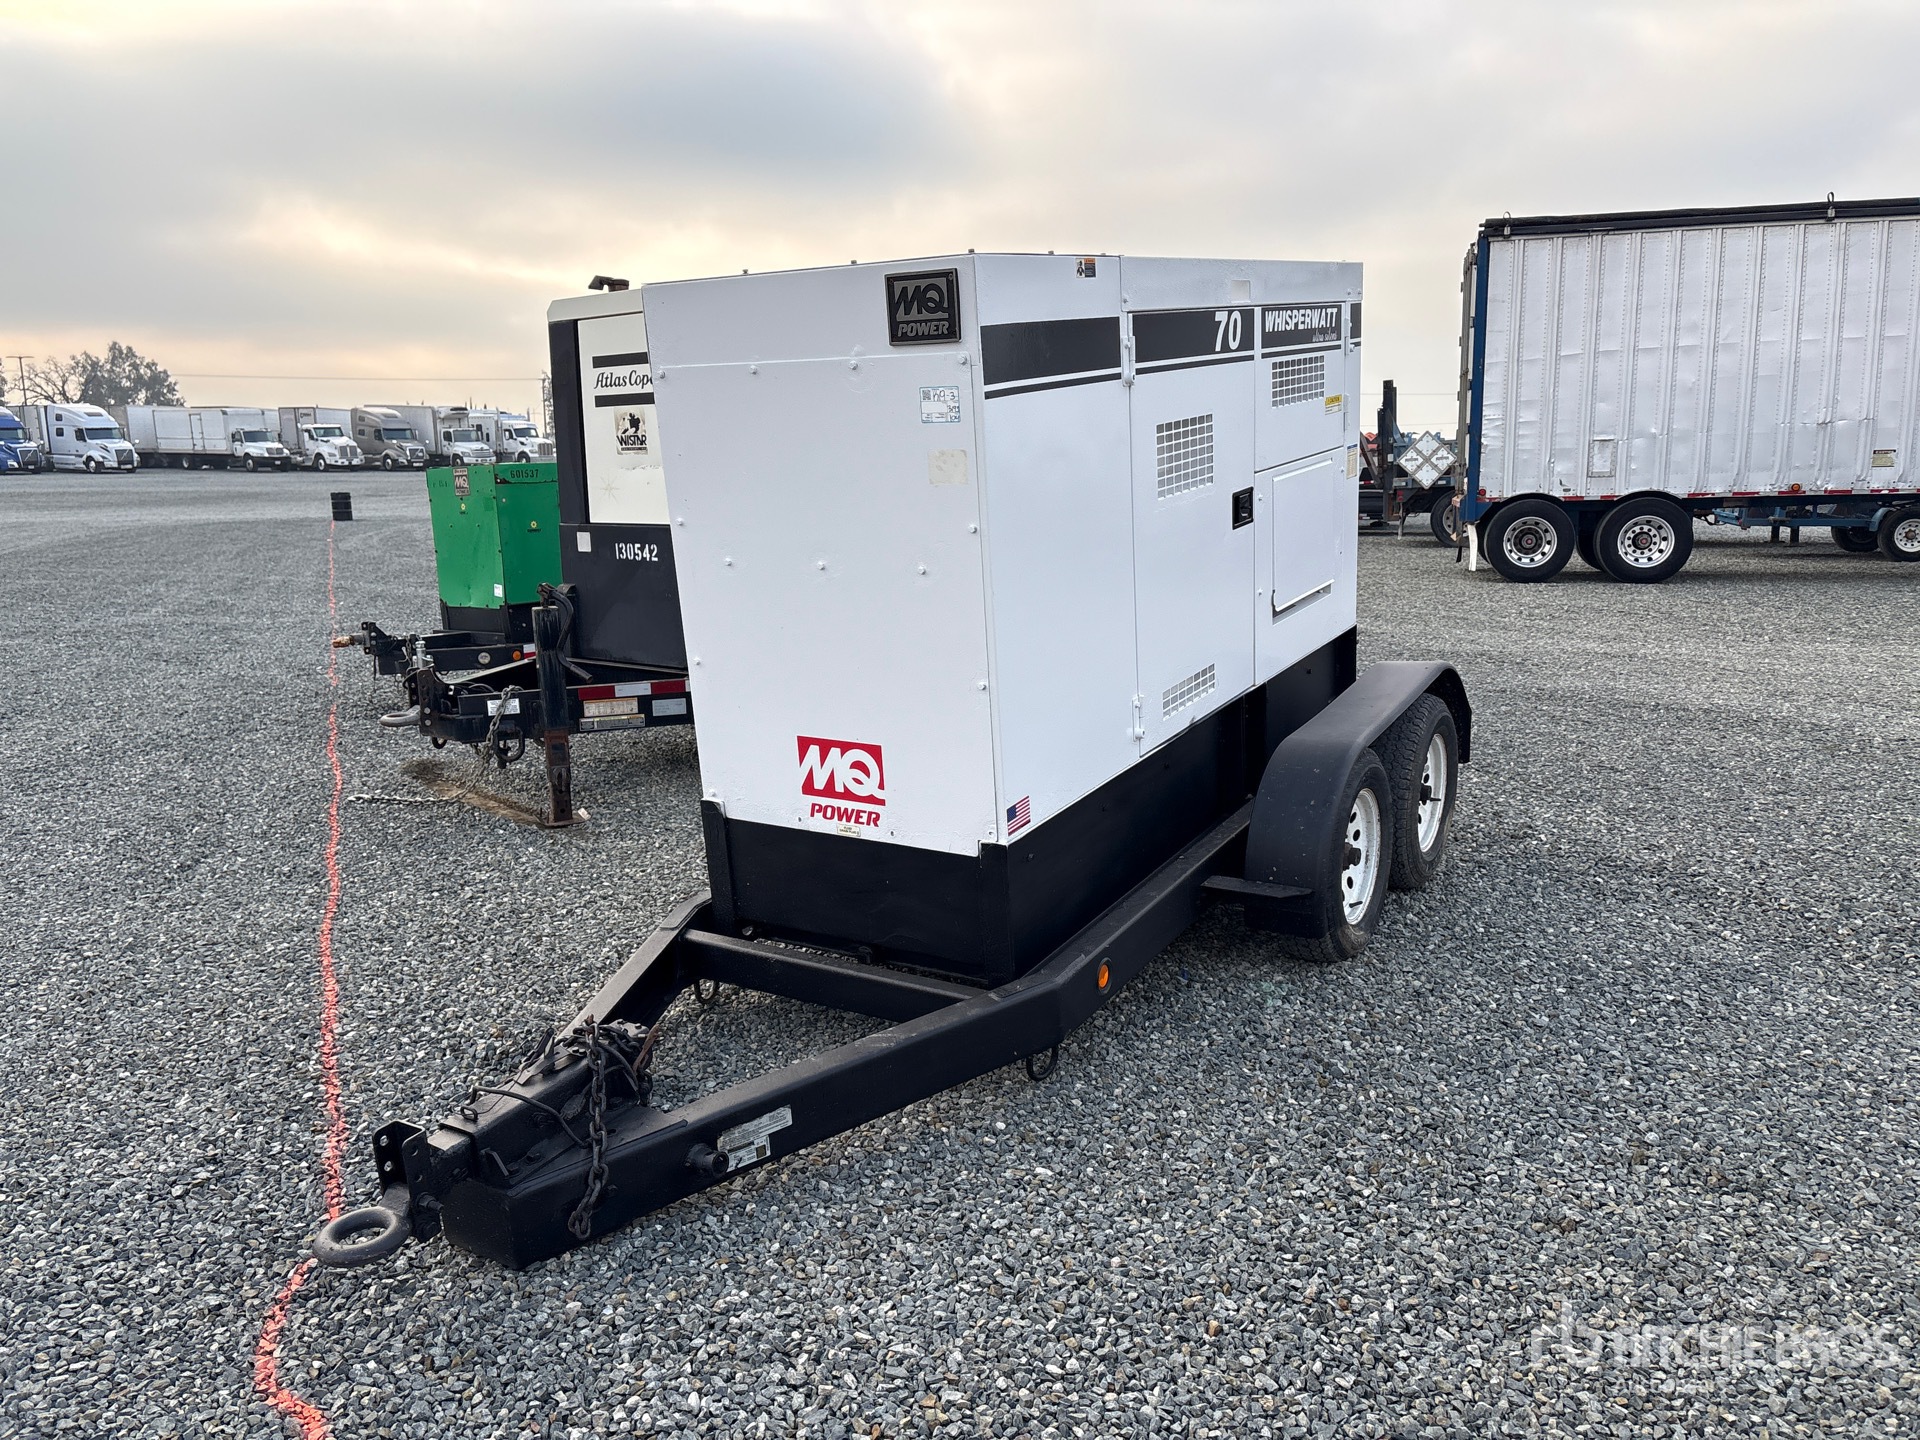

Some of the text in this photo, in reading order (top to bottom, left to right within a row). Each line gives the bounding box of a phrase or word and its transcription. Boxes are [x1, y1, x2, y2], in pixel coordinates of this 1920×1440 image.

[894, 283, 949, 316] MQ
[897, 321, 949, 337] POWER
[1214, 310, 1242, 352] 70
[1265, 308, 1338, 333] WHISPERWATT
[593, 371, 627, 389] Atlas
[510, 469, 539, 478] 601537
[615, 543, 658, 561] 130542
[799, 744, 885, 797] MQ
[810, 803, 881, 827] POWER
